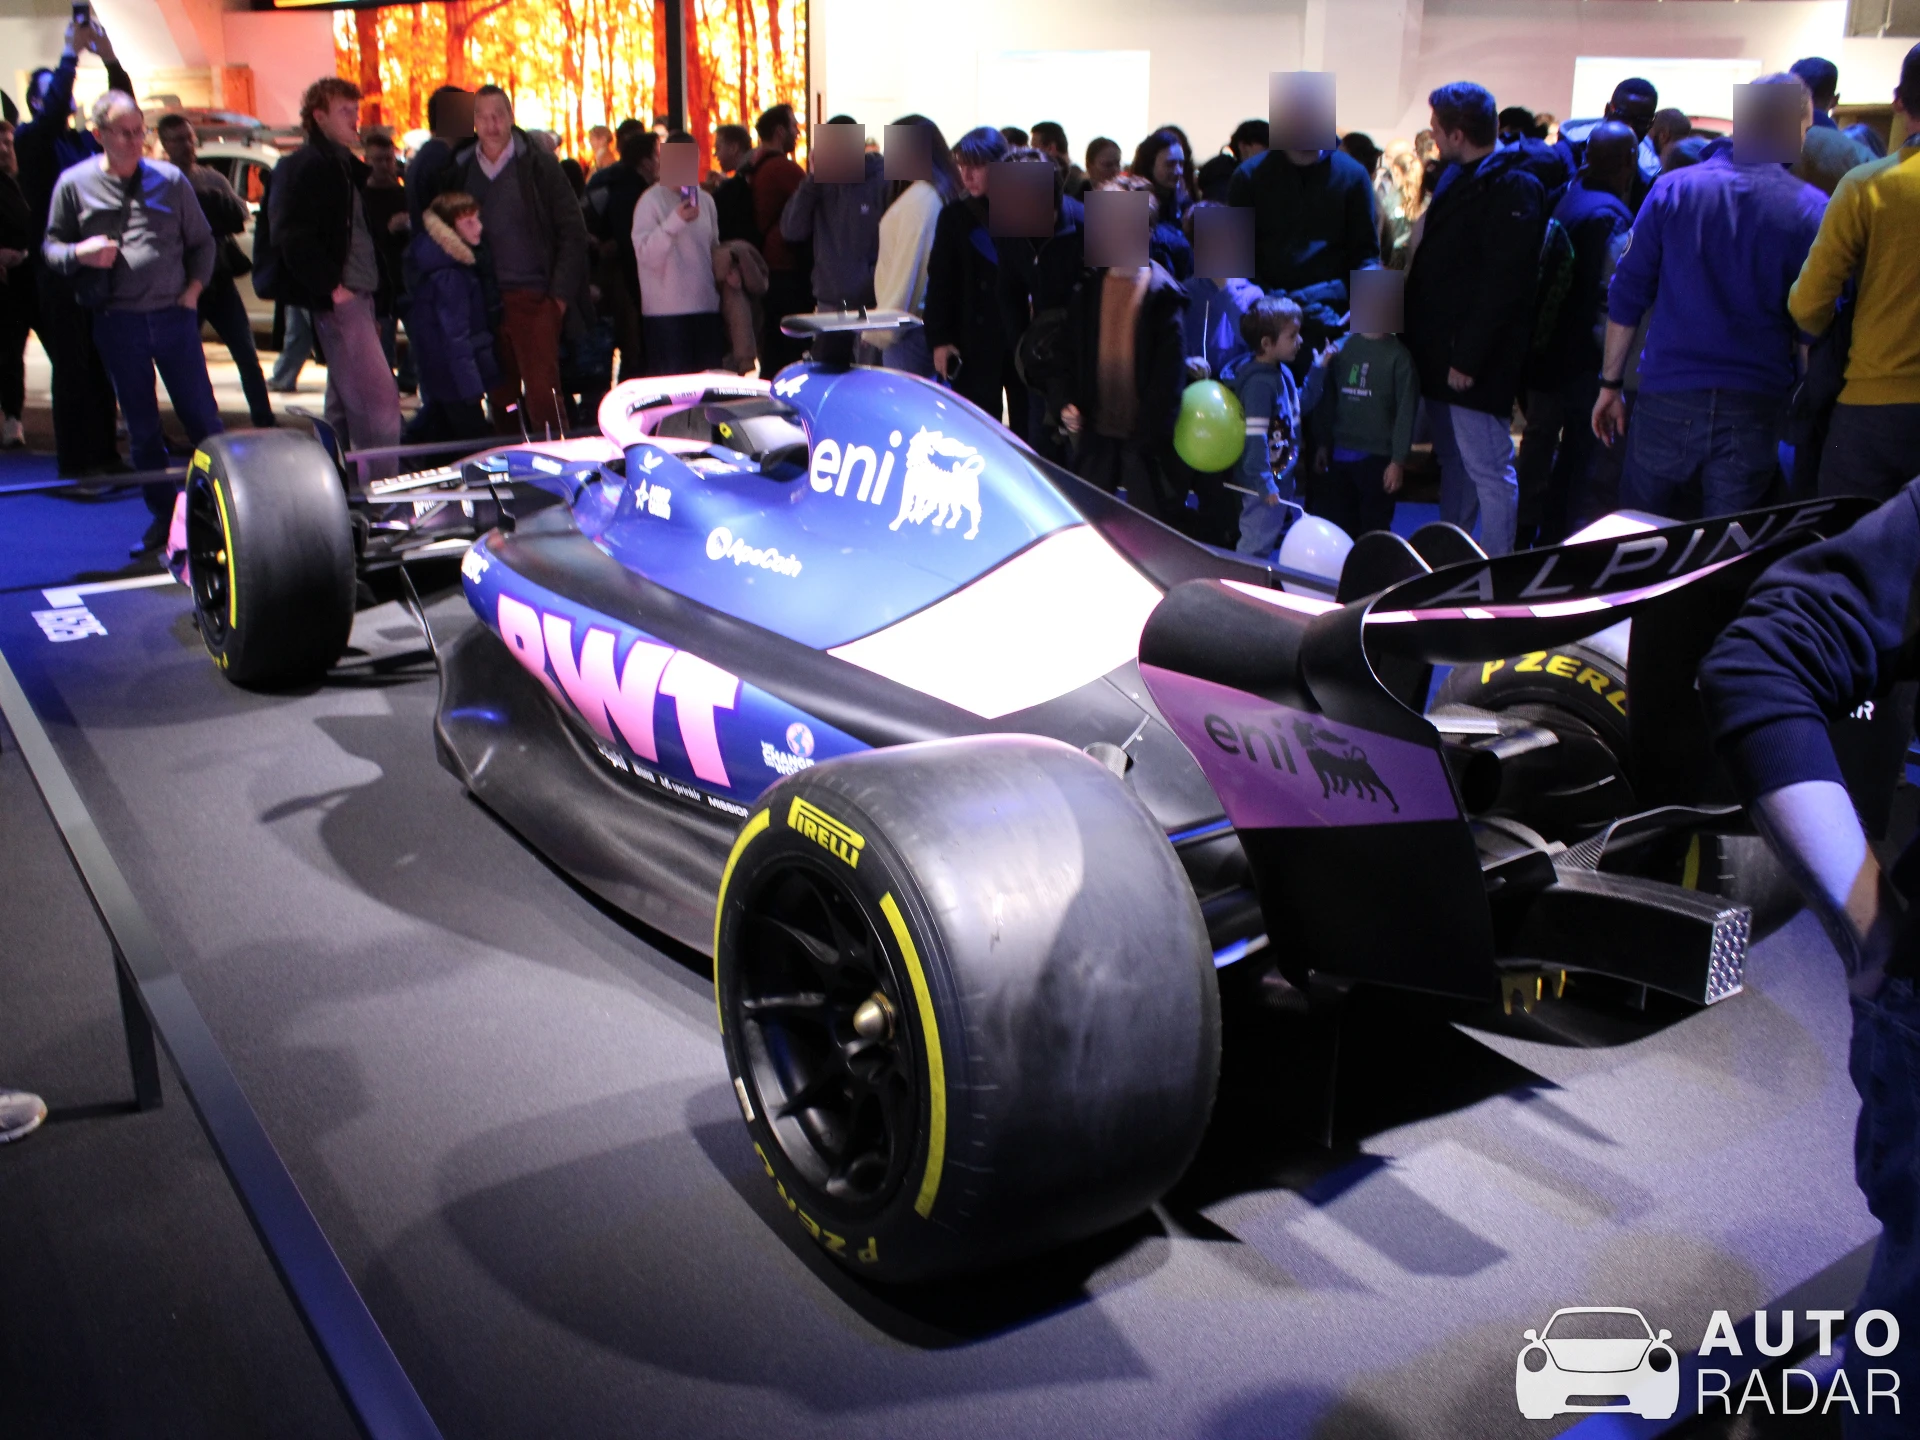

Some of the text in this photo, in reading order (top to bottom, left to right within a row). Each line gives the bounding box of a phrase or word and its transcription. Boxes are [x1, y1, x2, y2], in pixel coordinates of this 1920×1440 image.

[810, 430, 902, 505] eni
[1408, 502, 1836, 608] ALPINE
[1480, 659, 1505, 684] P
[1204, 713, 1298, 775] eni
[787, 796, 865, 869] PIRELLI
